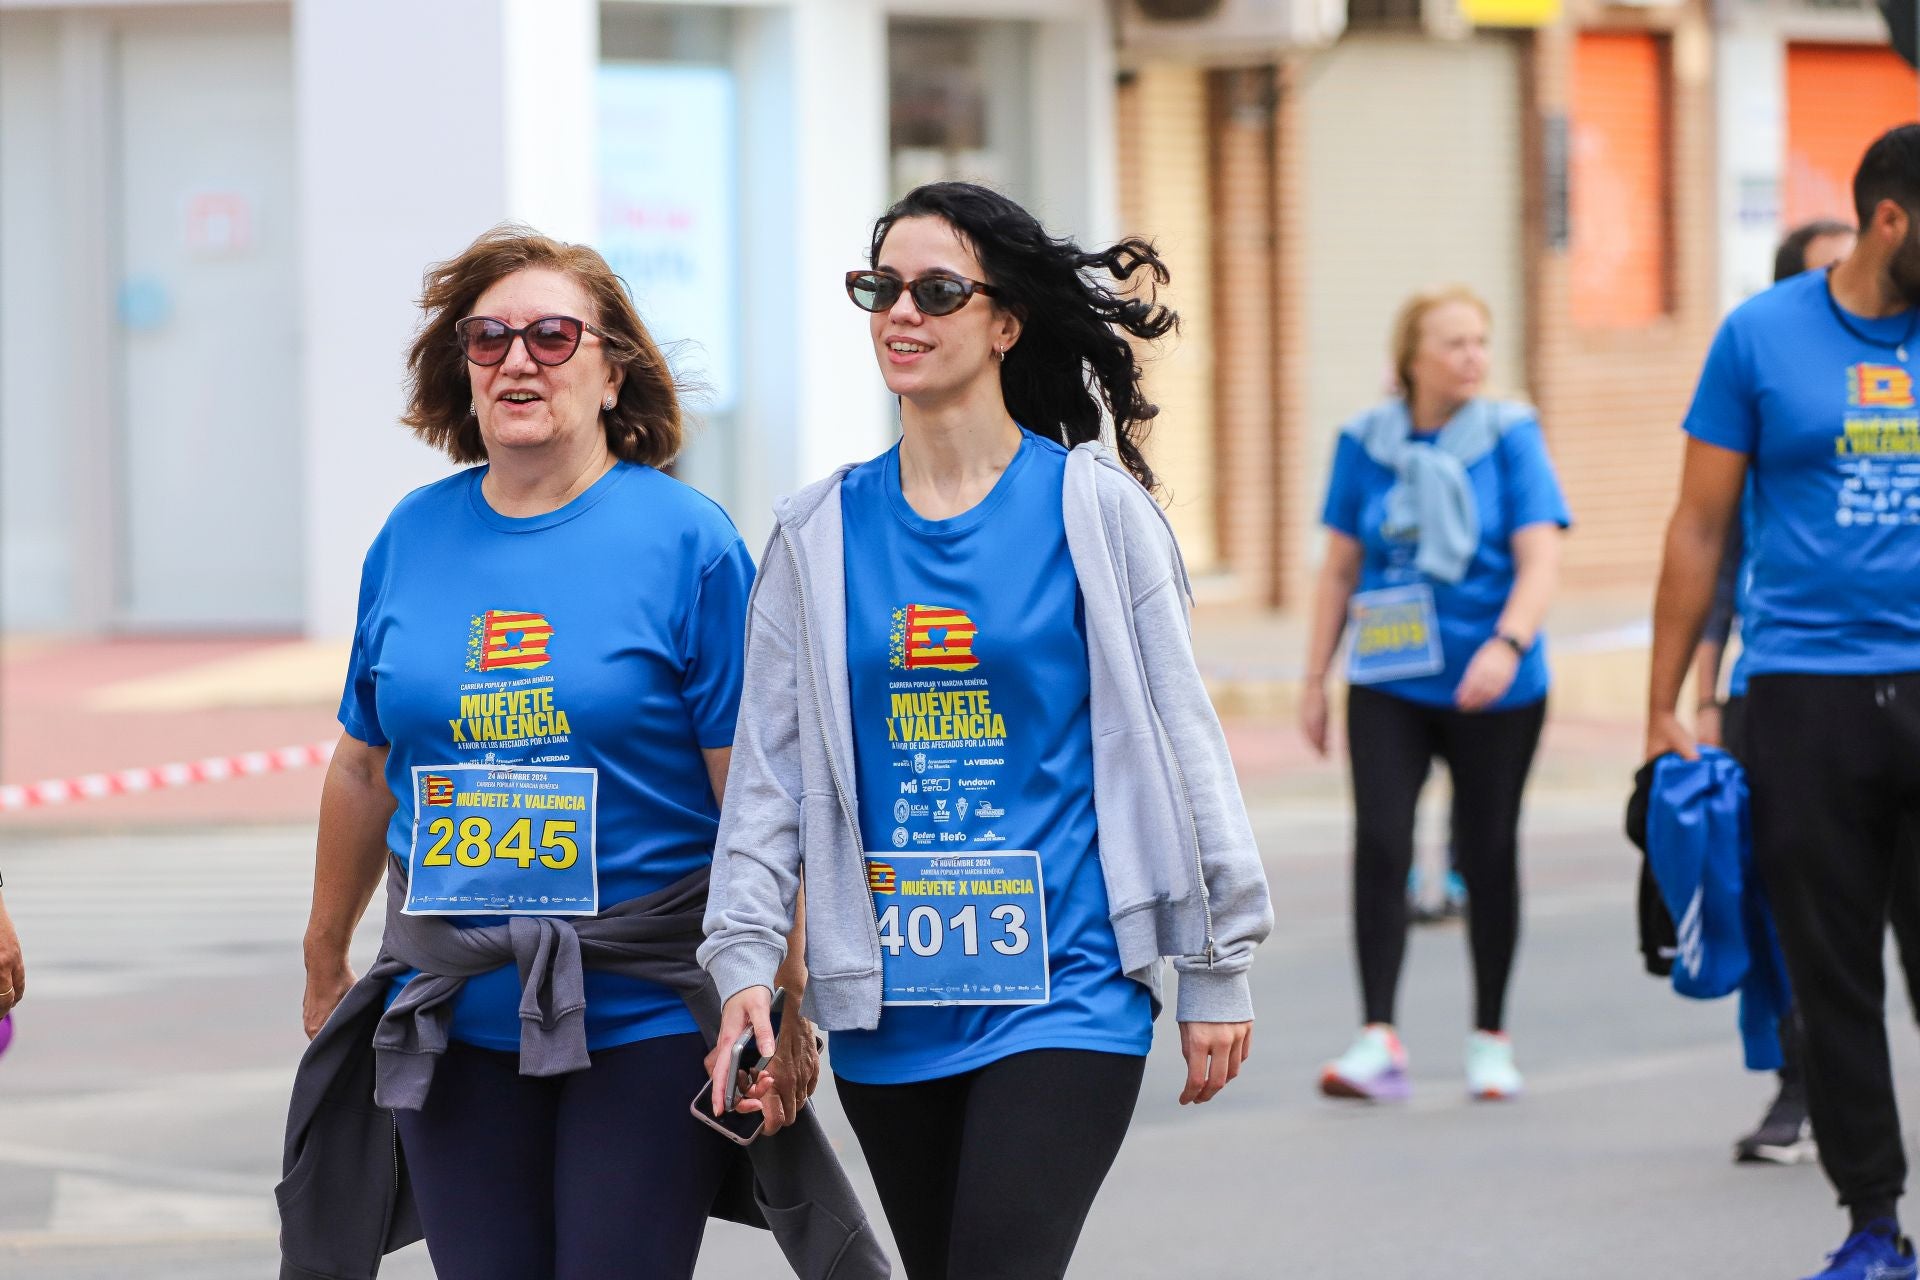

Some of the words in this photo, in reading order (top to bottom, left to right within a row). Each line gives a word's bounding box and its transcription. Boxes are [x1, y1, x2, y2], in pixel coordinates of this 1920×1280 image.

[461, 682, 484, 691] CARRERA
[485, 680, 507, 689] POPULAR
[512, 677, 531, 687] MARCHA
[889, 681, 912, 689] CARRERA
[913, 680, 936, 688] POPULAR
[941, 679, 963, 687] MARCHA
[964, 677, 988, 686] BENÉFICA
[460, 687, 555, 719] MUÉVETE
[890, 687, 992, 718] MUÉVETE
[449, 719, 467, 742] X
[468, 710, 571, 742] VALENCIA
[886, 717, 898, 742] X
[900, 713, 1007, 742] VALENCIA
[462, 741, 480, 750] FAVOR
[480, 741, 487, 749] DE
[488, 740, 498, 749] LOS
[499, 738, 529, 748] AFECTADOS
[530, 737, 543, 746] POR
[543, 736, 551, 745] LA
[553, 735, 569, 744] DANA
[910, 742, 917, 750] DE
[919, 741, 930, 749] LOS
[931, 739, 963, 749] AFECTADOS
[965, 738, 977, 748] POR
[979, 738, 986, 747] LA
[987, 737, 1004, 747] DANA
[497, 773, 530, 781] NOVIEMBRE
[532, 773, 548, 781] 2024
[958, 777, 996, 787] fundown
[456, 790, 510, 809] MUÉVETE
[511, 793, 522, 809] X
[525, 794, 586, 811] VALENCIA
[422, 816, 579, 871] 2845
[940, 832, 967, 842] Hero
[930, 859, 939, 867] 24
[940, 859, 974, 867] NOVIEMBRE
[975, 859, 991, 867] 2024
[941, 868, 960, 876] POPULAR
[901, 878, 956, 896] MUÉVETE
[959, 880, 969, 896] X
[971, 879, 1034, 896] VALENCIA
[878, 904, 1031, 957] 4013
